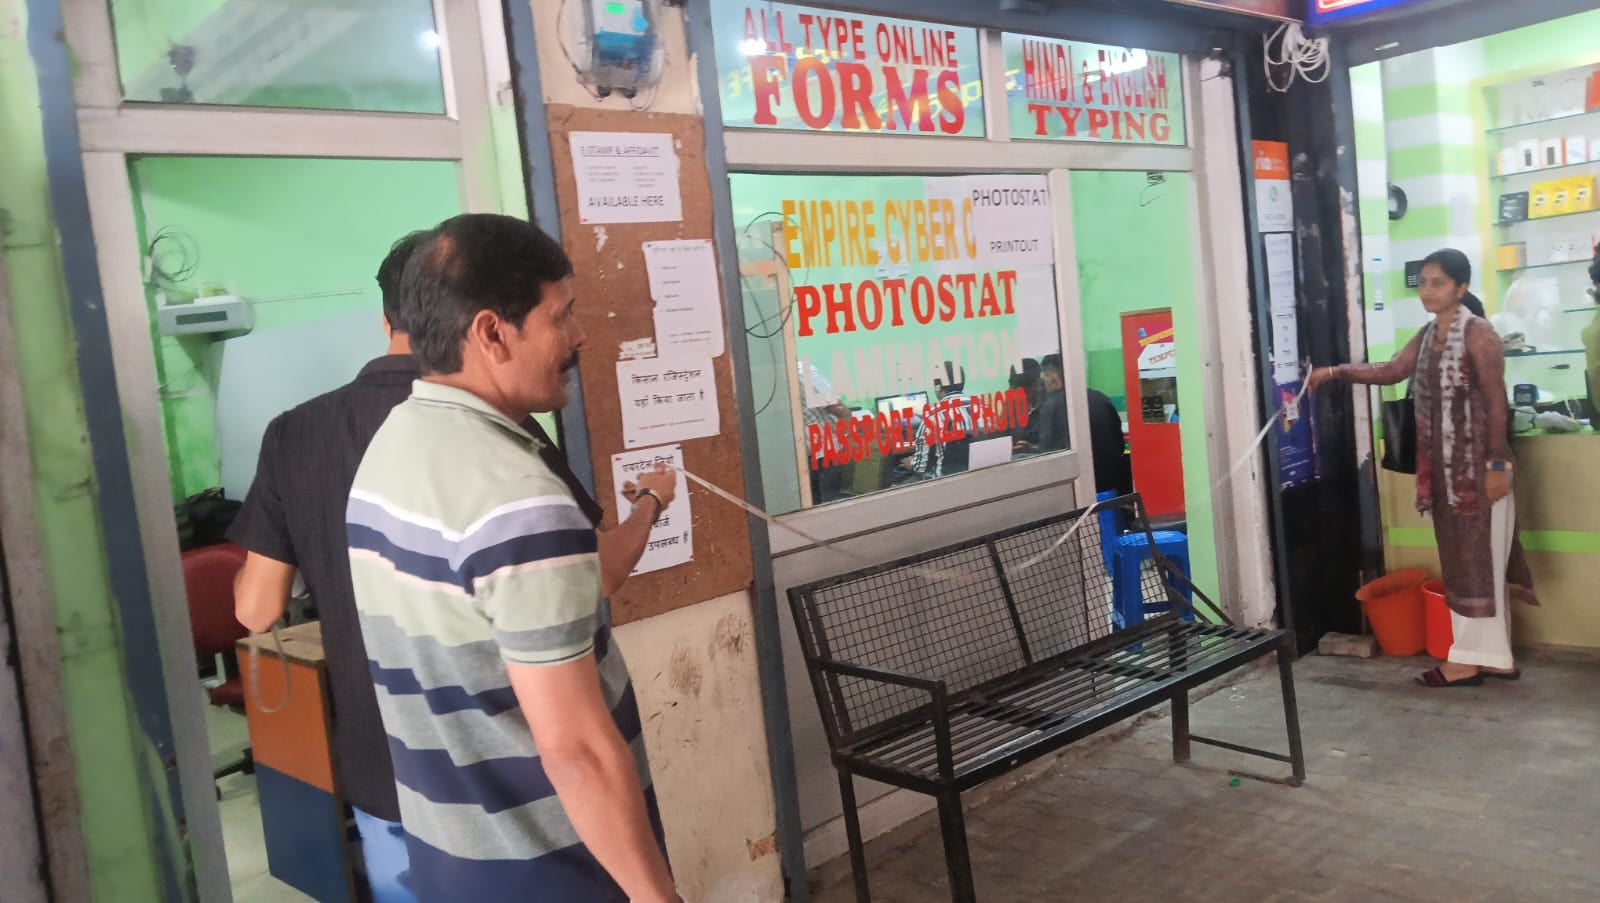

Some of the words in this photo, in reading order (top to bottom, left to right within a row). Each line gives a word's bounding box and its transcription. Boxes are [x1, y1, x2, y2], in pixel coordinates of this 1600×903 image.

[743, 8, 792, 54] ALL
[798, 13, 866, 60] TYPE
[875, 23, 958, 68] ONLINE
[746, 55, 965, 134] FORMS
[1022, 39, 1076, 103] HINDI
[1082, 60, 1095, 105] &
[1028, 103, 1170, 141] TYPING
[588, 195, 640, 208] AVAILABLE
[642, 195, 664, 207] HERE
[972, 189, 1048, 207] PHOTOSTAT
[782, 199, 880, 269] EMPIRE
[884, 198, 959, 265] CYBER
[990, 239, 1039, 254] PRINTOUT
[793, 270, 1017, 337] PHOTOSTAT
[798, 328, 1025, 409] LAMINATION
[808, 406, 915, 471] PASSPORT
[922, 396, 967, 447] SIZE
[970, 386, 1029, 437] PHOTO
